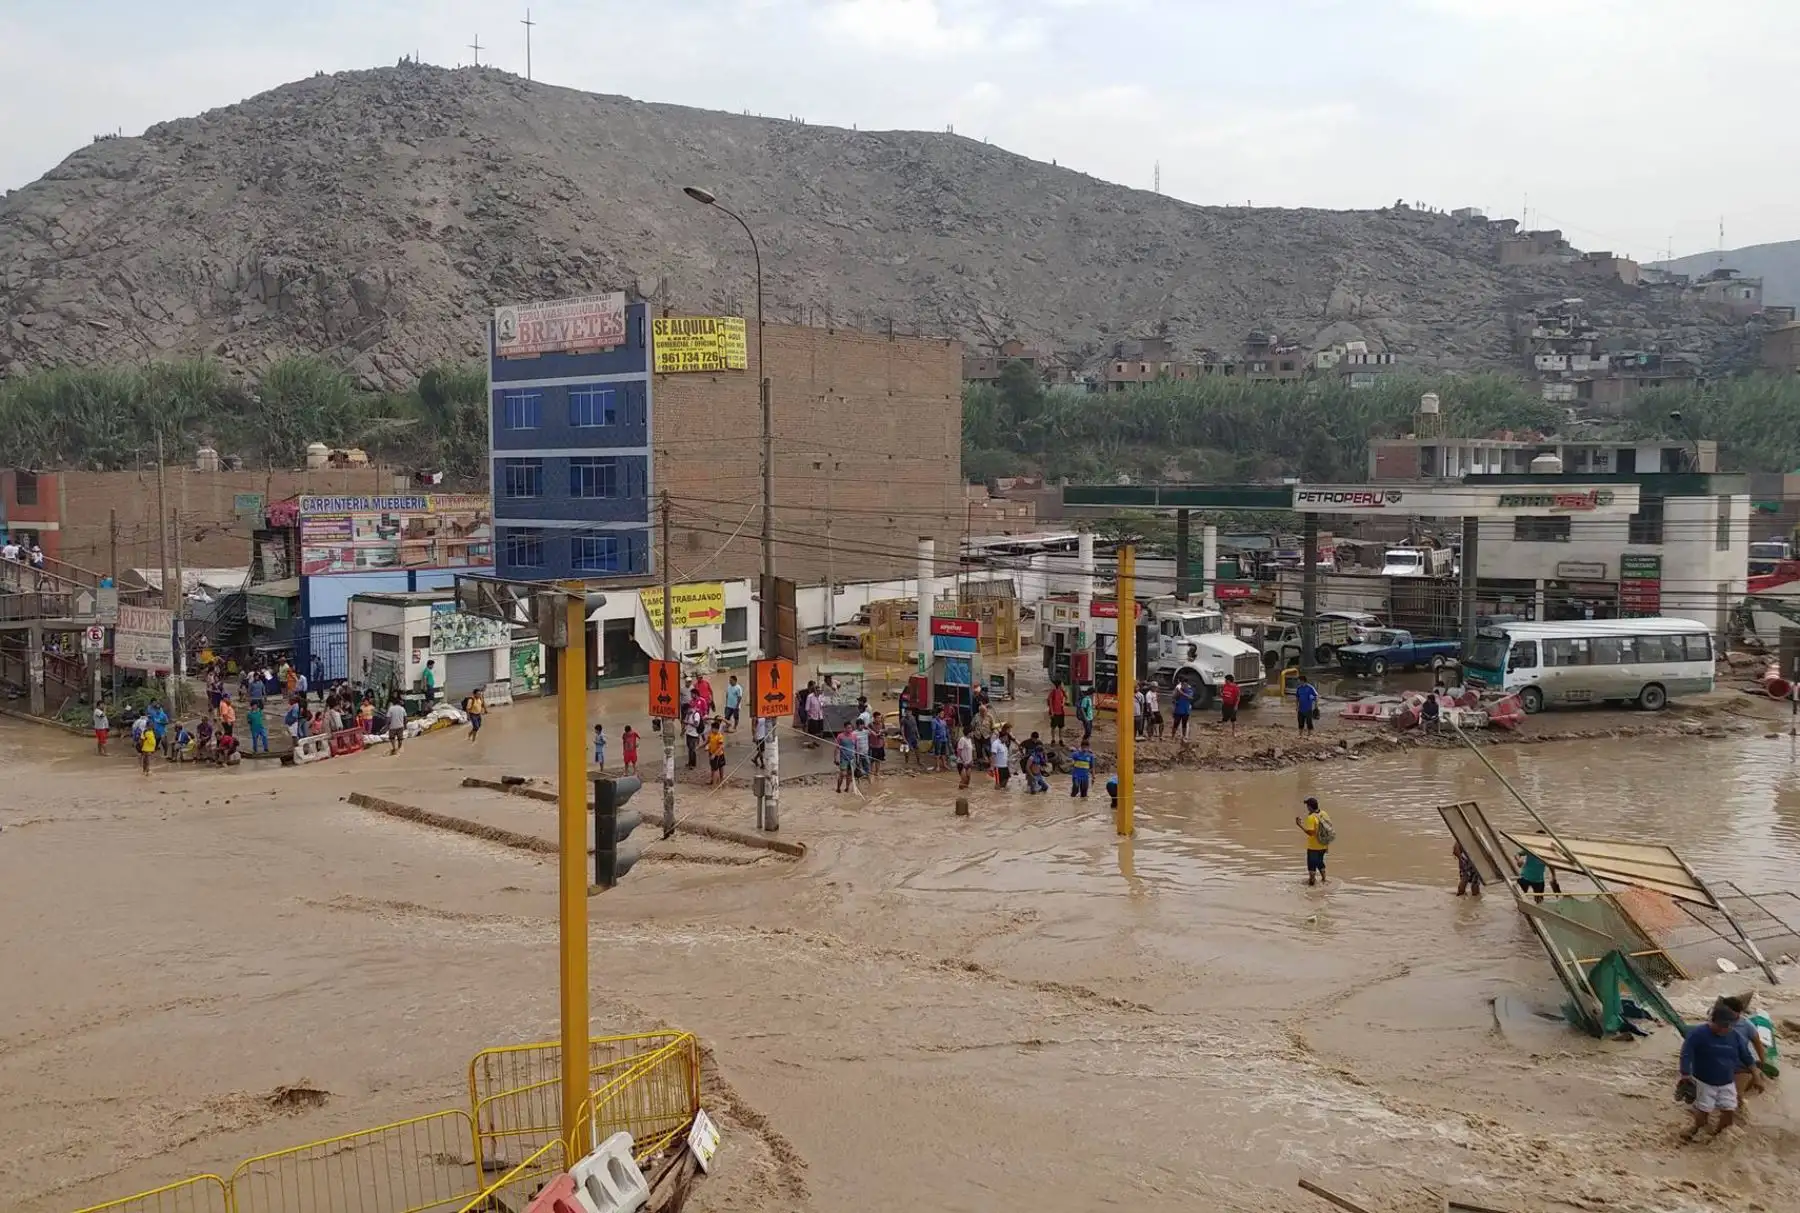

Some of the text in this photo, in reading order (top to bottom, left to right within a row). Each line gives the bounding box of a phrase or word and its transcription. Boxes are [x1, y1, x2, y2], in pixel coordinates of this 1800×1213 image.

[518, 307, 624, 345] BREVETES
[654, 319, 717, 336] SE ALQUILA
[656, 341, 689, 349] COMERCIAL
[661, 352, 681, 364] 961
[682, 352, 700, 363] 734
[702, 351, 719, 363] 726
[302, 497, 370, 512] CARPINTERIA
[372, 496, 427, 510] MUEBLERIA
[671, 592, 722, 604] TRABAJANDO
[652, 704, 676, 715] PEATON
[761, 703, 789, 714] PEATON
